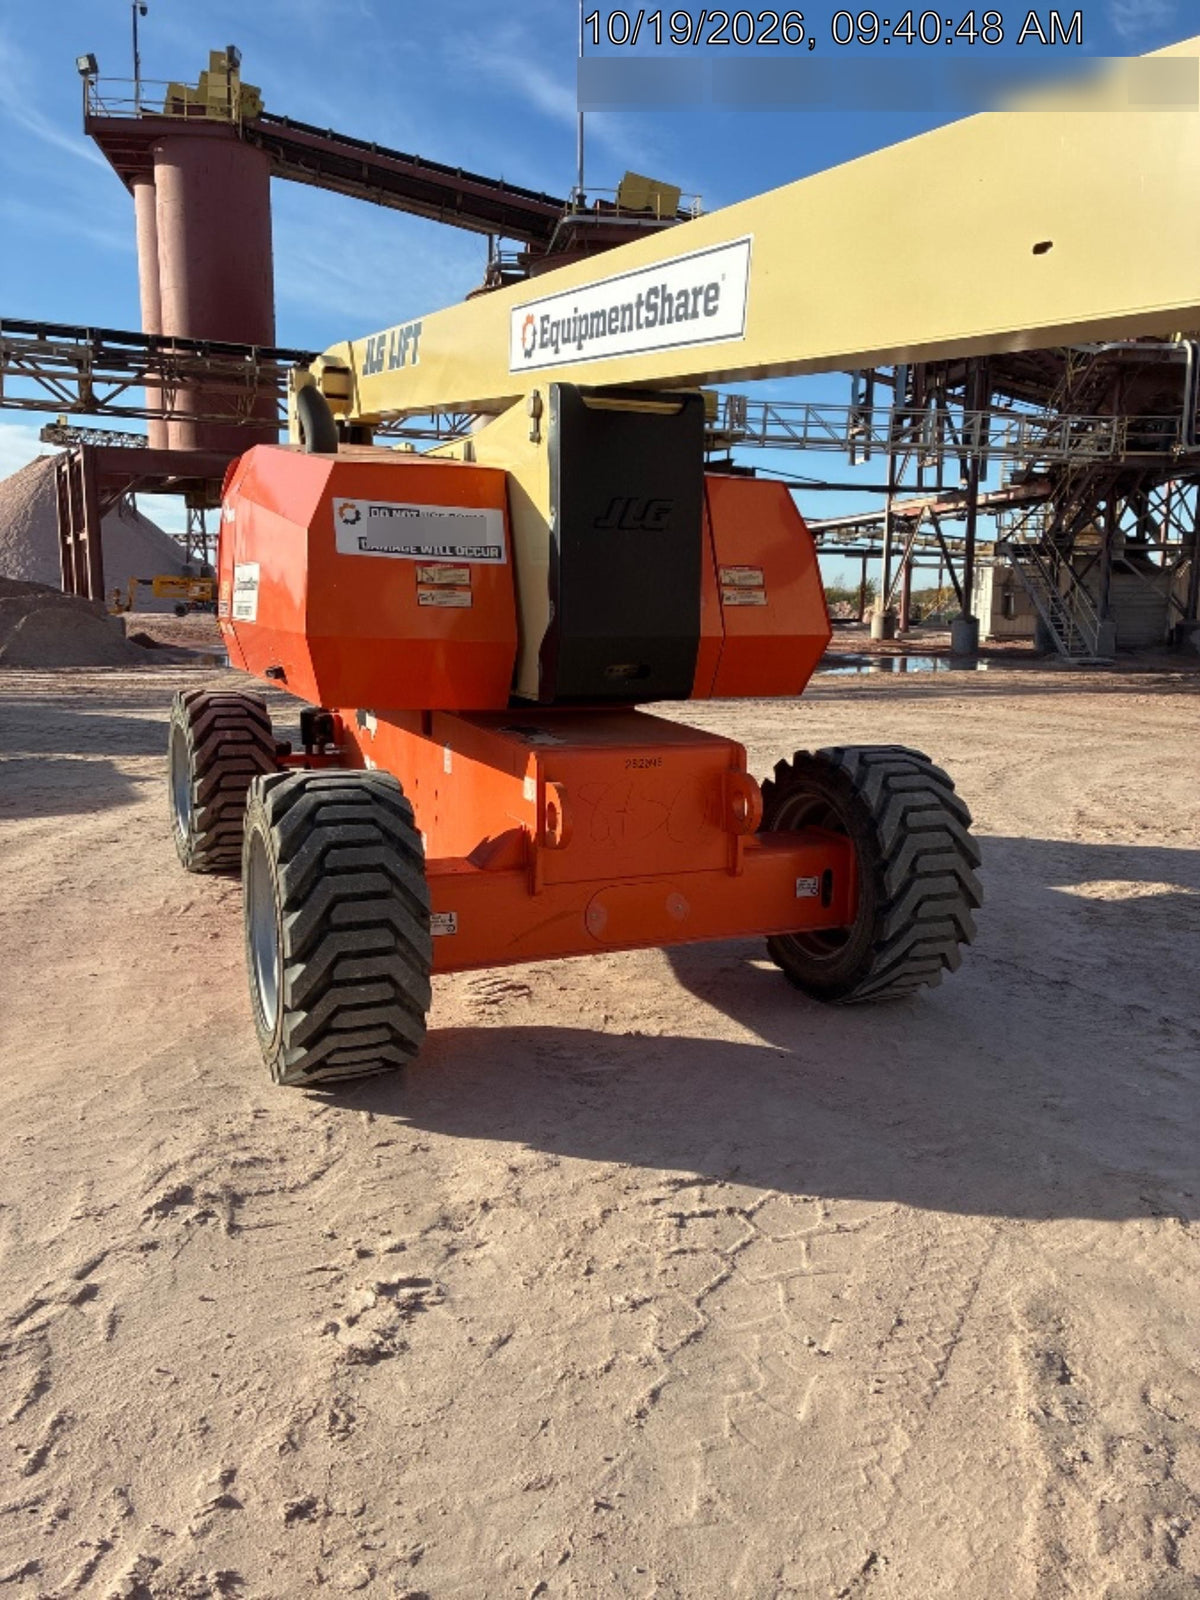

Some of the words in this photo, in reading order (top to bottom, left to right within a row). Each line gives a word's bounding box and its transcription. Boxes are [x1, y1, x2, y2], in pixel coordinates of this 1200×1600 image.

[540, 281, 720, 354] EquipmentShare
[362, 334, 386, 376] JLG
[388, 321, 422, 370] LIFT
[371, 508, 388, 518] DO
[594, 497, 673, 531] JLG
[421, 545, 454, 555] WILL
[456, 546, 499, 557] OCCUR
